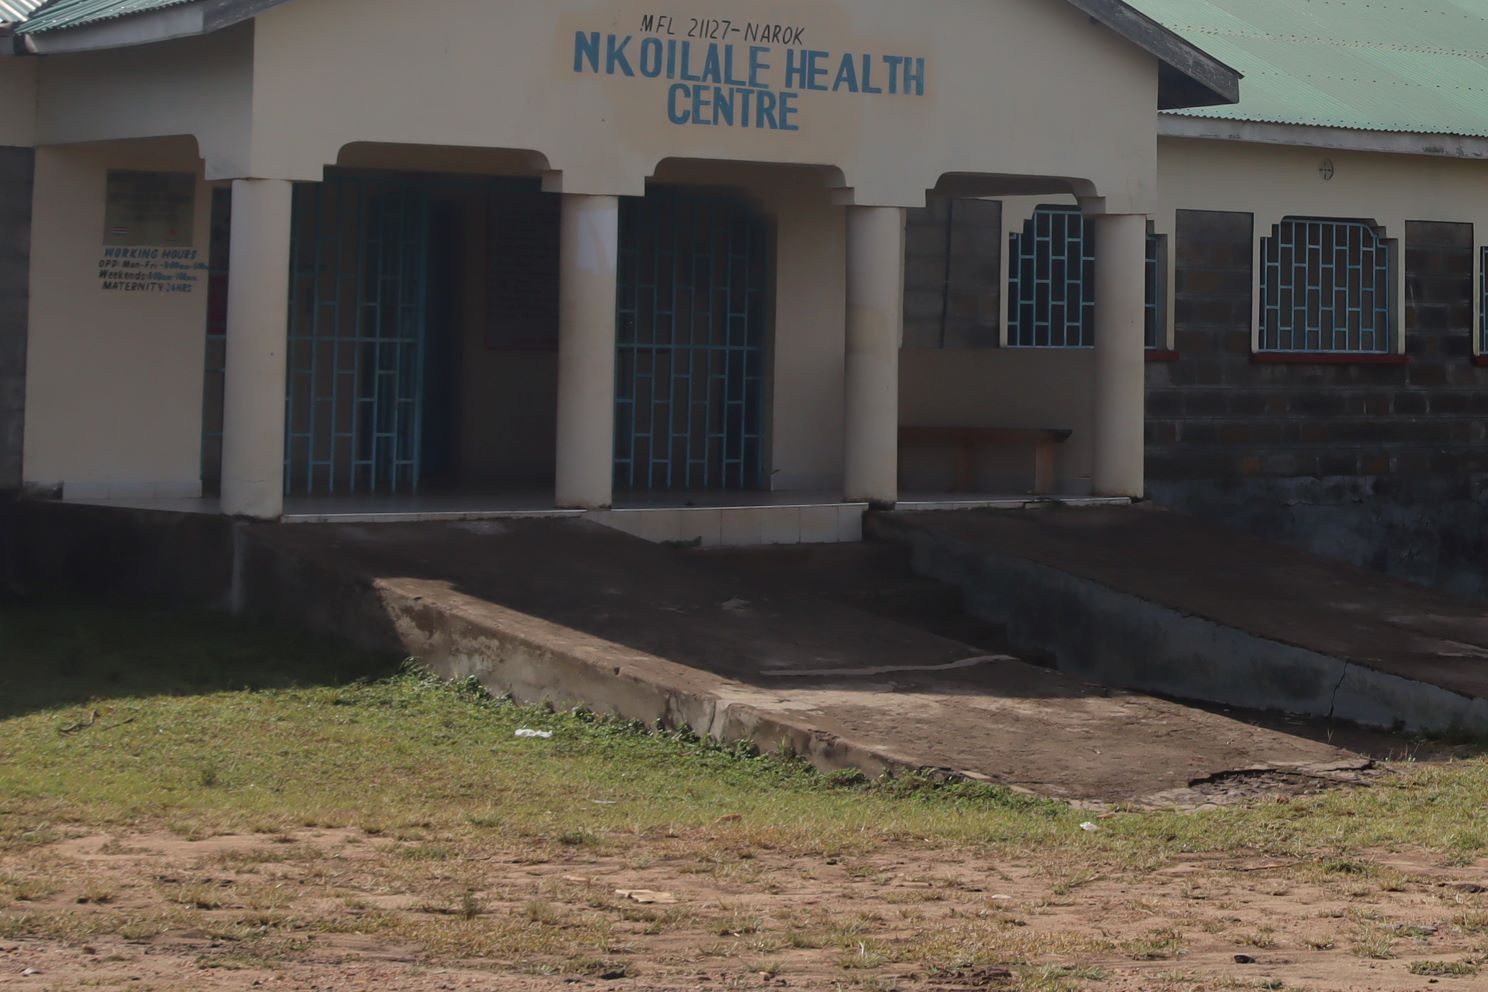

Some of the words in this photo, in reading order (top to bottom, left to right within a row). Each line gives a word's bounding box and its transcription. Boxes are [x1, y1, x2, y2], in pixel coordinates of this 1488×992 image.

[640, 14, 675, 35] MFL
[573, 31, 772, 90] NKOILALE
[784, 48, 925, 97] HEALTH
[667, 83, 800, 132] CENTRE
[104, 248, 159, 259] WORKING
[162, 249, 198, 260] HOURS
[102, 281, 164, 292] MATERNITY
